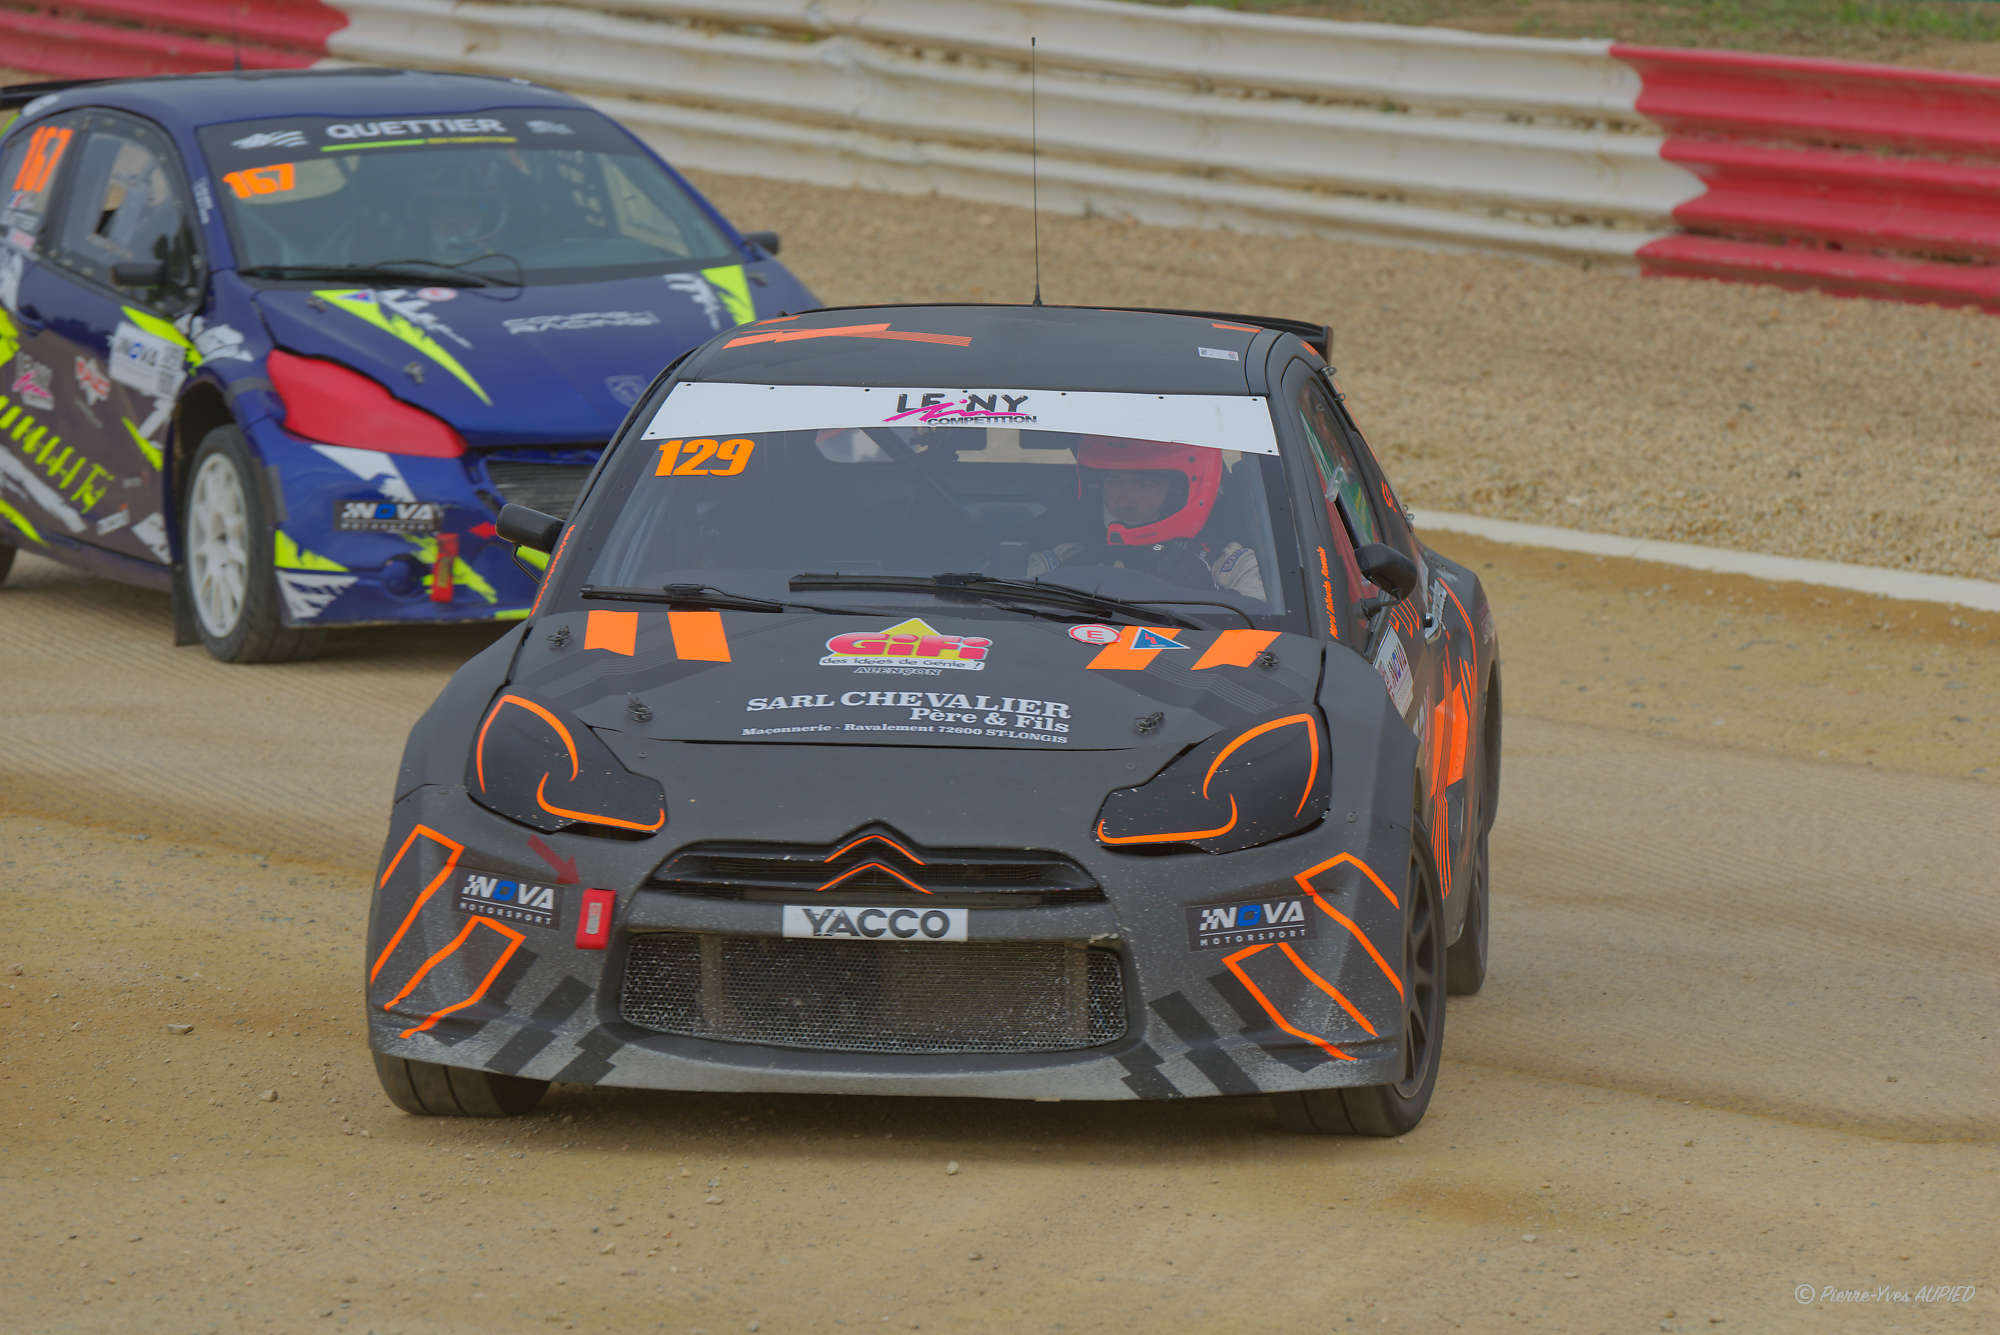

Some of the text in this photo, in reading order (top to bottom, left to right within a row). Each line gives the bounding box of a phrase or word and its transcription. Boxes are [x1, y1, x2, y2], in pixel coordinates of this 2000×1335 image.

[325, 118, 507, 139] QUETTIER
[222, 162, 296, 199] 167
[926, 414, 1038, 426] COMPETITION
[655, 438, 756, 477] 129
[341, 502, 434, 519] NOVA
[746, 691, 1072, 719] SARL CHEVALIER
[741, 723, 832, 736] Maçonnerie
[844, 723, 935, 732] Ravalement
[938, 726, 982, 735] 72600
[910, 708, 1070, 733] Père & Fils
[462, 874, 555, 910] NOVA
[458, 902, 553, 925] MOTORSPORT
[802, 908, 950, 939] YACCO
[1200, 900, 1305, 931] NOVA
[1200, 929, 1306, 947] MOTORSPORT
